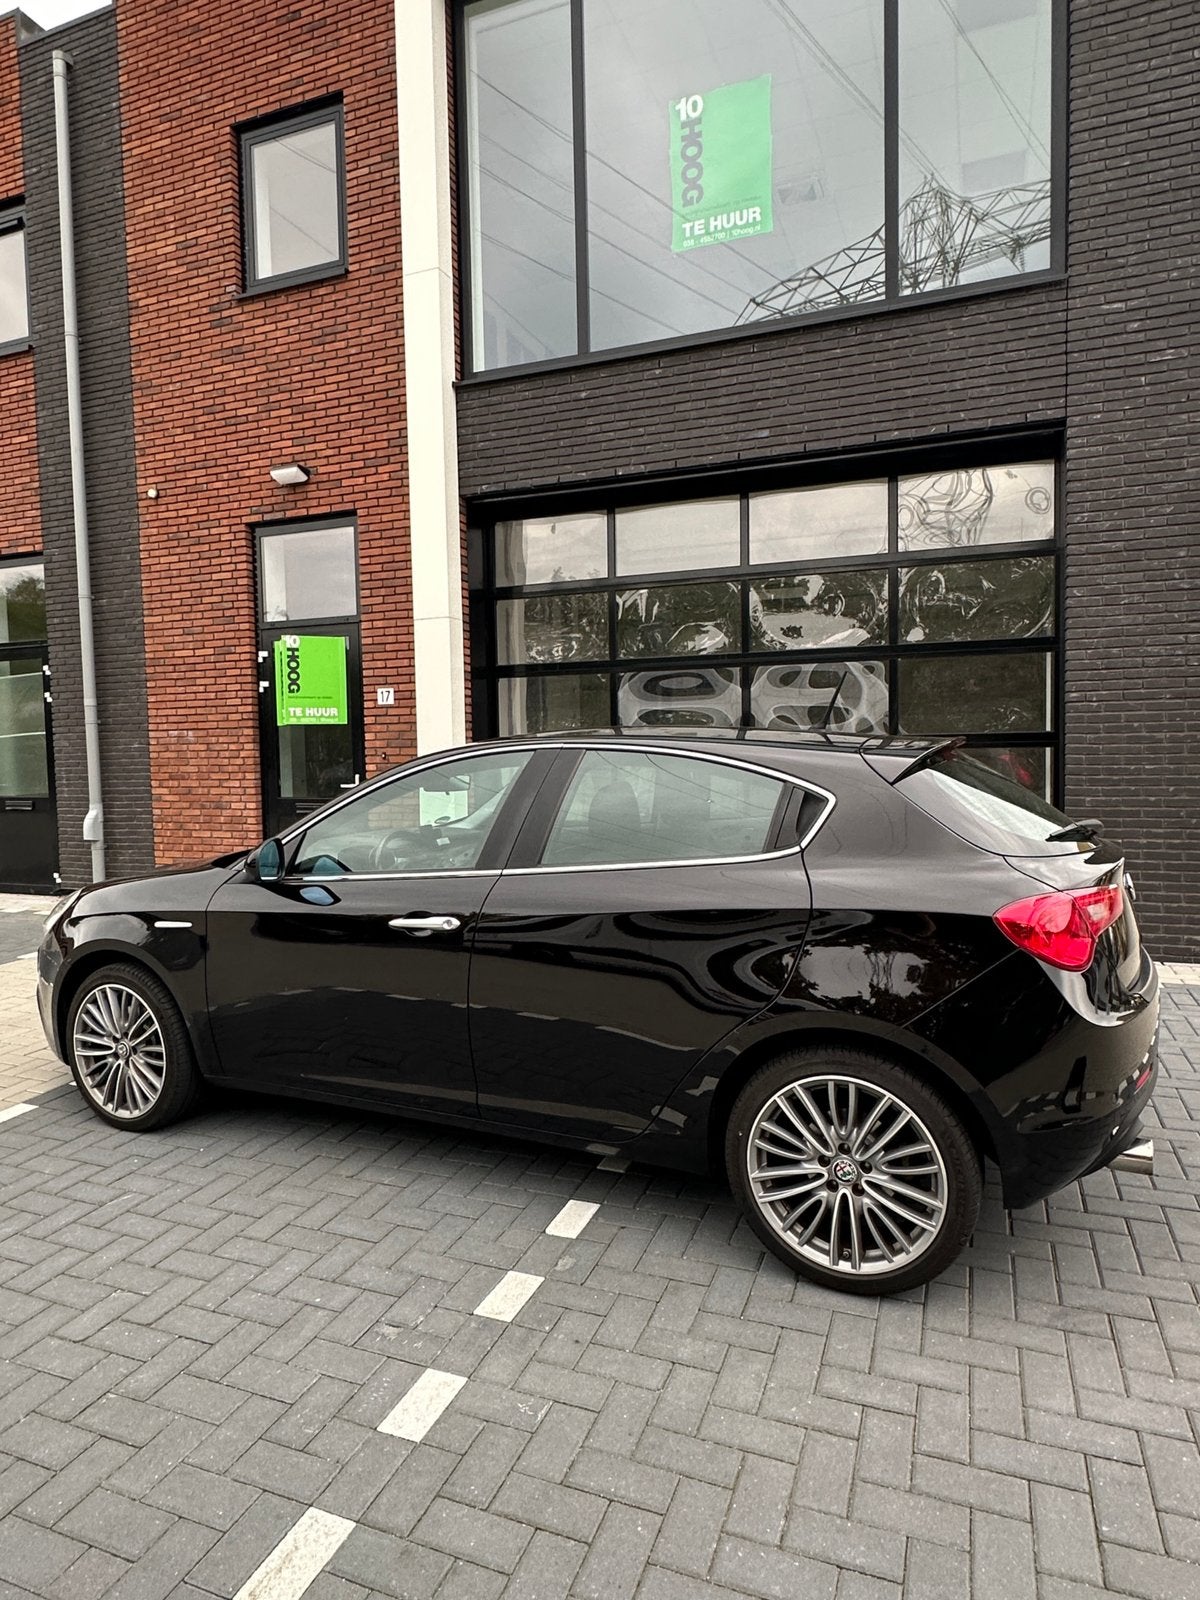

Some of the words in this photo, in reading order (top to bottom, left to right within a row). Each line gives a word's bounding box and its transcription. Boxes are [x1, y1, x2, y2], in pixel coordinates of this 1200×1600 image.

[676, 95, 703, 121] 10
[681, 117, 704, 208] HOOG
[682, 219, 705, 237] TE
[710, 206, 761, 232] HUUR
[287, 648, 300, 693] HOOG
[380, 691, 391, 703] 17
[288, 707, 303, 717] TE
[305, 707, 338, 717] HUUR
